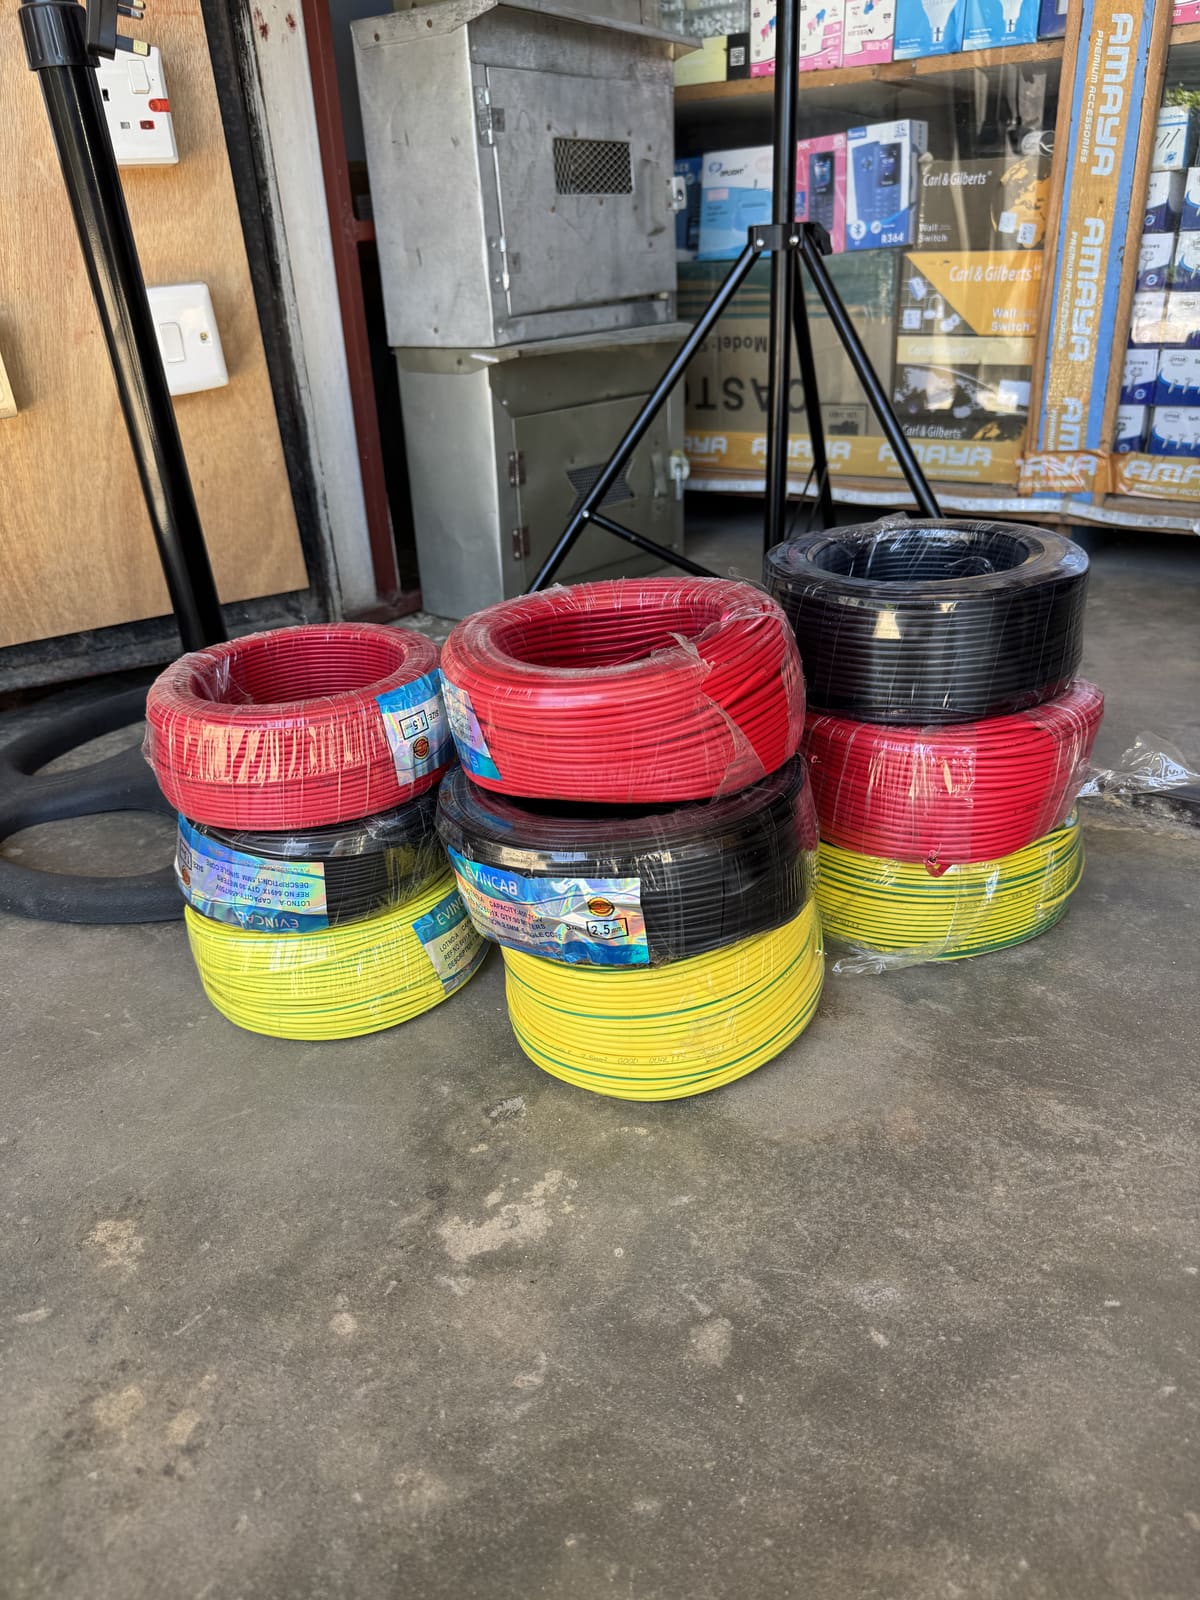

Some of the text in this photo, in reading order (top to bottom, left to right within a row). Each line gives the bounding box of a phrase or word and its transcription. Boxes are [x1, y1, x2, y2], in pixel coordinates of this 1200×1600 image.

[1079, 29, 1104, 164] PREMIUM ACCESSORIES
[1090, 13, 1134, 176] AMAYA
[922, 171, 987, 187] Carl & Gilberts
[920, 223, 939, 232] Wall
[919, 233, 948, 242] Switch
[949, 265, 1032, 282] Carl & Gilberts
[1067, 217, 1105, 362] AMAYA
[992, 308, 1017, 317] Wall
[991, 321, 1031, 332] Switch
[711, 335, 768, 353] Model:
[902, 424, 918, 436] Carl
[927, 424, 962, 439] Gilberts
[751, 437, 850, 460] AAA
[465, 864, 518, 896] EVINCAB
[617, 1057, 639, 1065] GOOD
